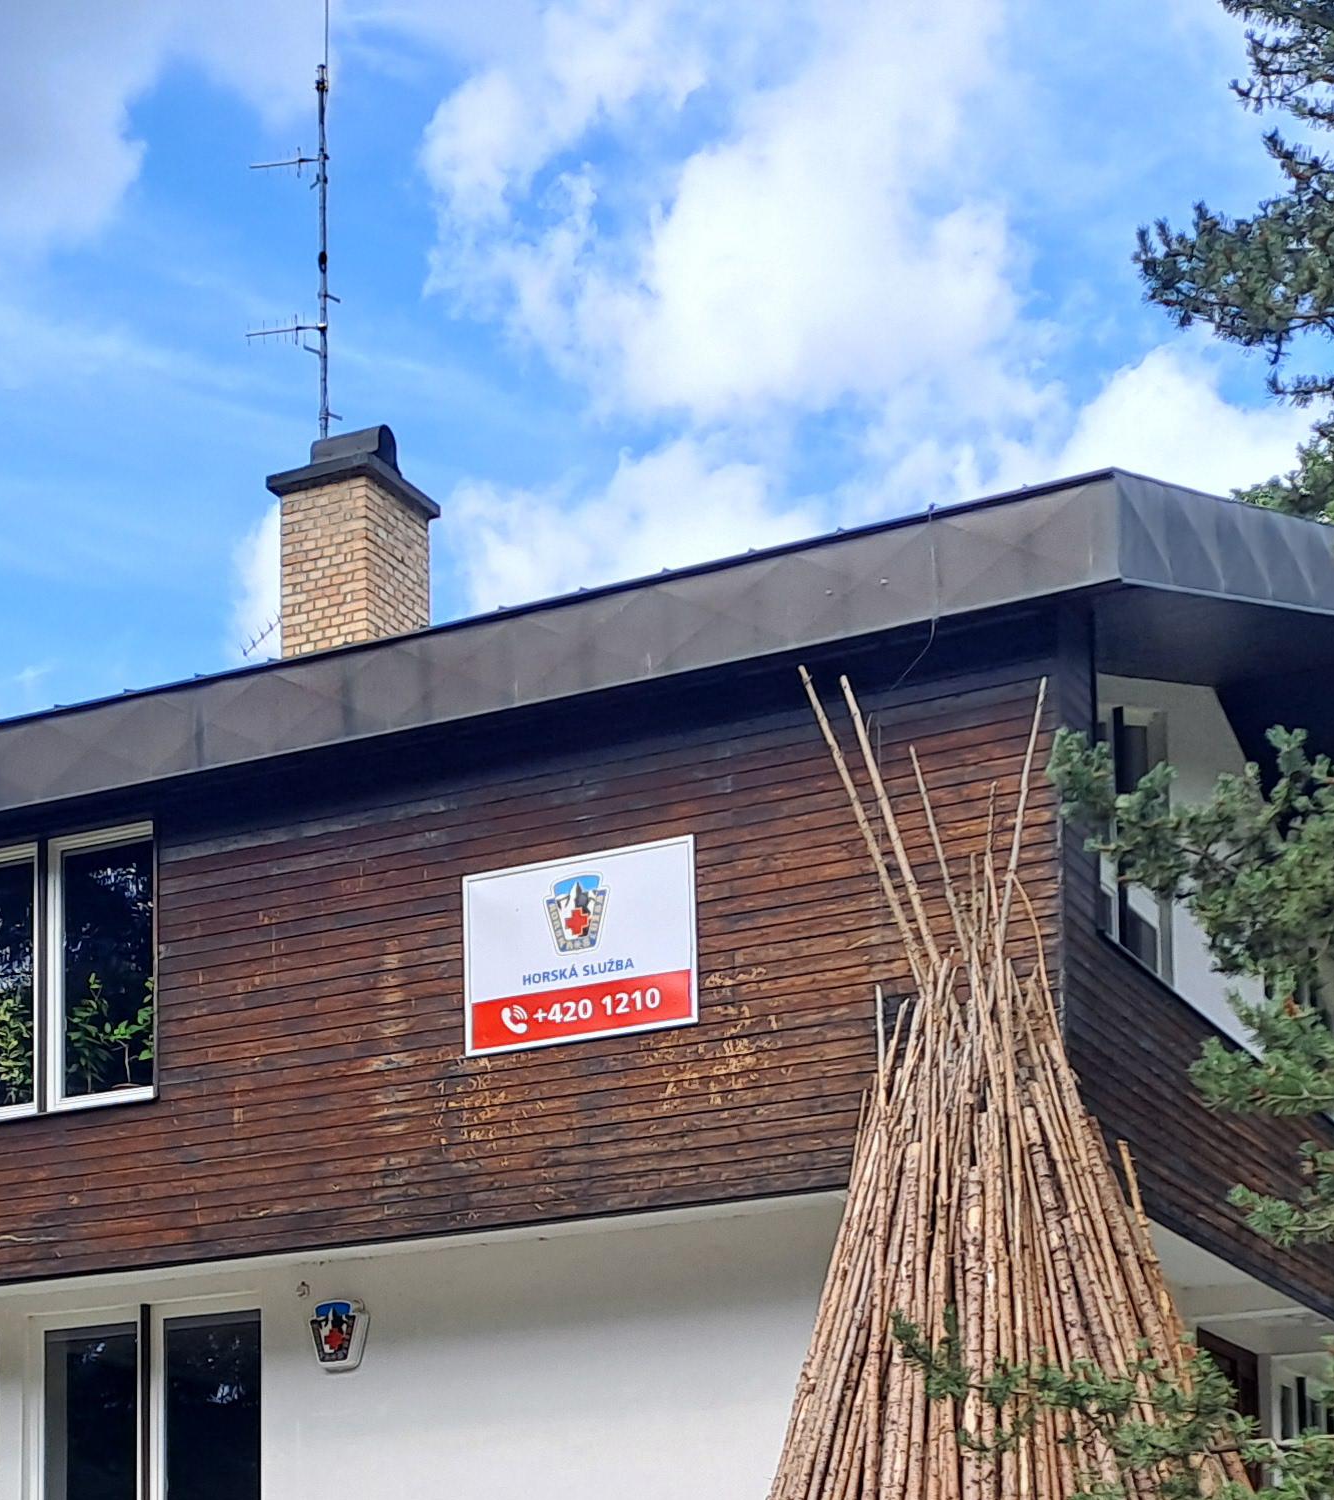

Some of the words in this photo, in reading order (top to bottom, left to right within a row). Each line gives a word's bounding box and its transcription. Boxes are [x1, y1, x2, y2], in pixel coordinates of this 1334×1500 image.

[522, 964, 578, 986] HORSKÁ
[582, 958, 635, 977] SLUŽBA
[533, 998, 593, 1024] +420
[601, 987, 661, 1016] 1210
